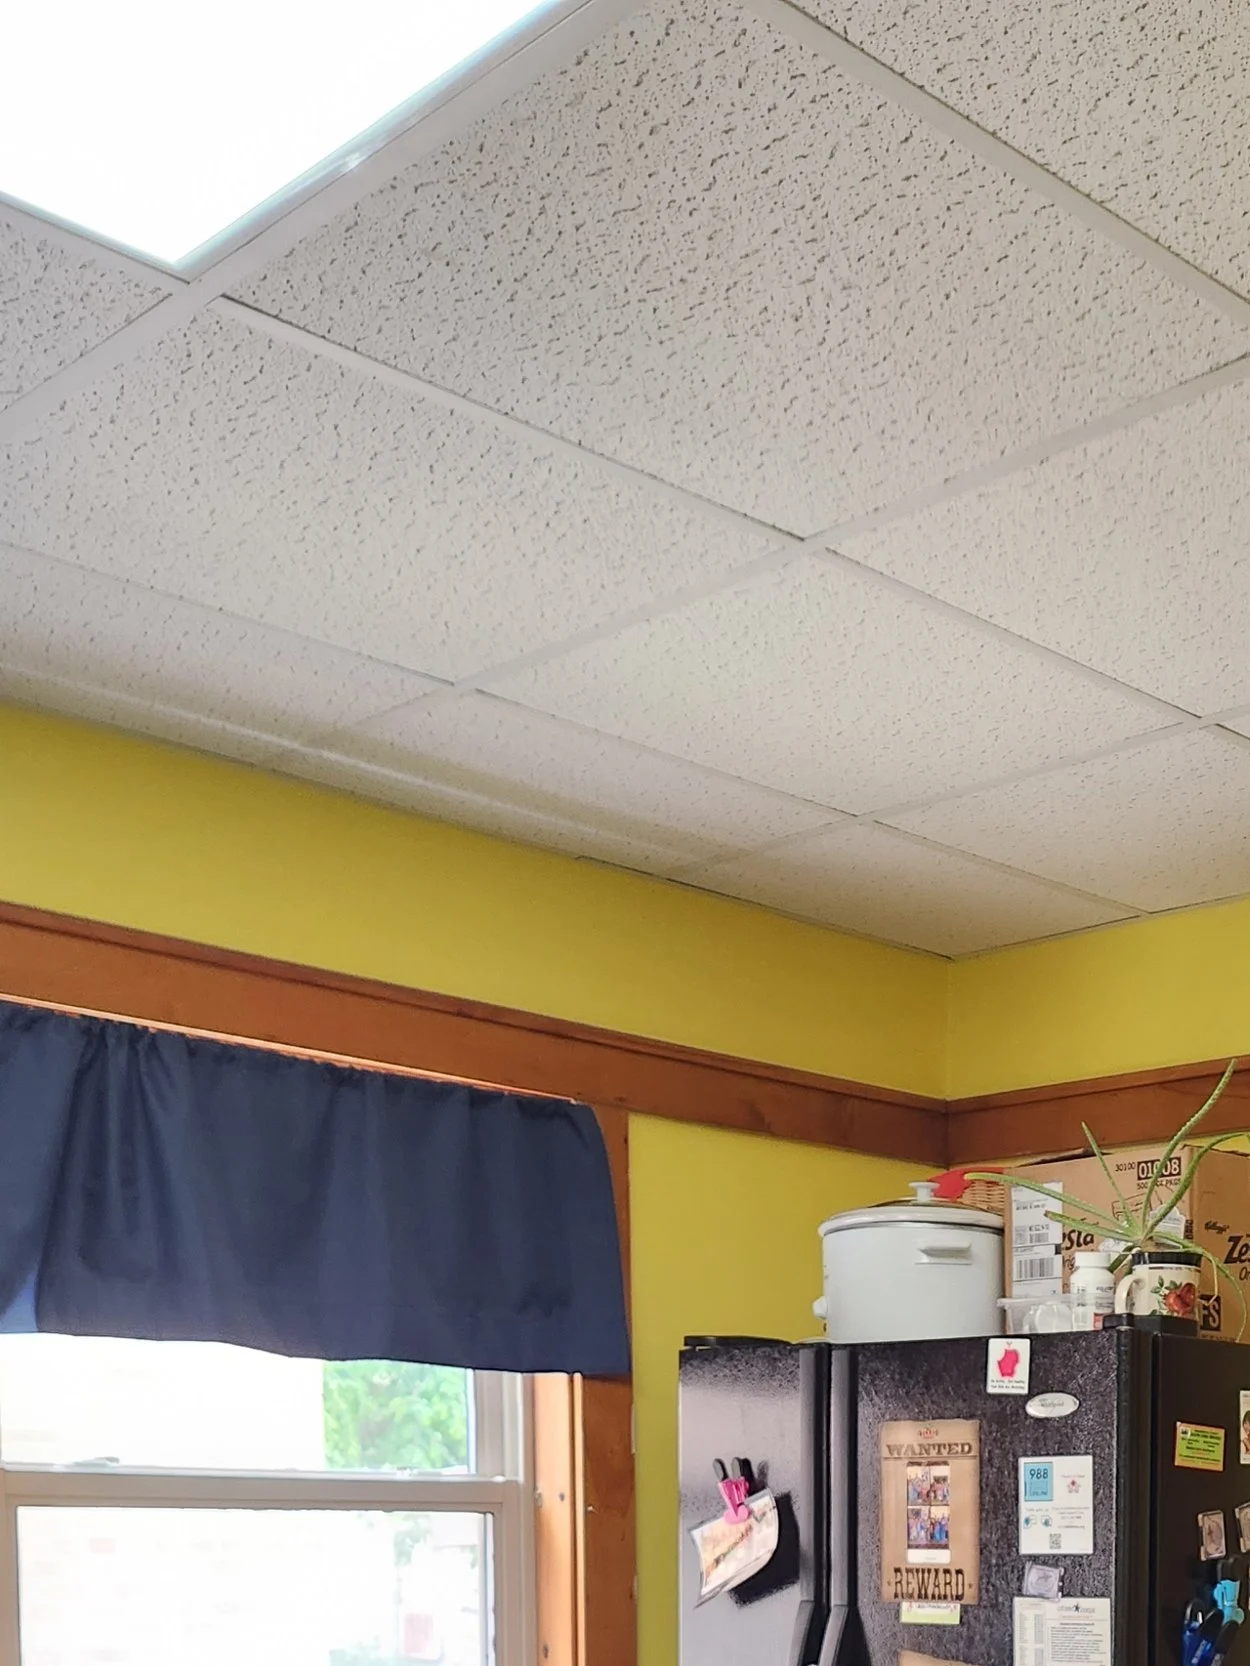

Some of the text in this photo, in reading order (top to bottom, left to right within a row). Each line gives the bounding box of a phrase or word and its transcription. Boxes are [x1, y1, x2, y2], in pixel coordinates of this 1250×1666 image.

[1115, 1162, 1136, 1172] 30100
[886, 1442, 973, 1458] WANTED
[1029, 1468, 1049, 1480] 988
[893, 1567, 965, 1602] REWARD
